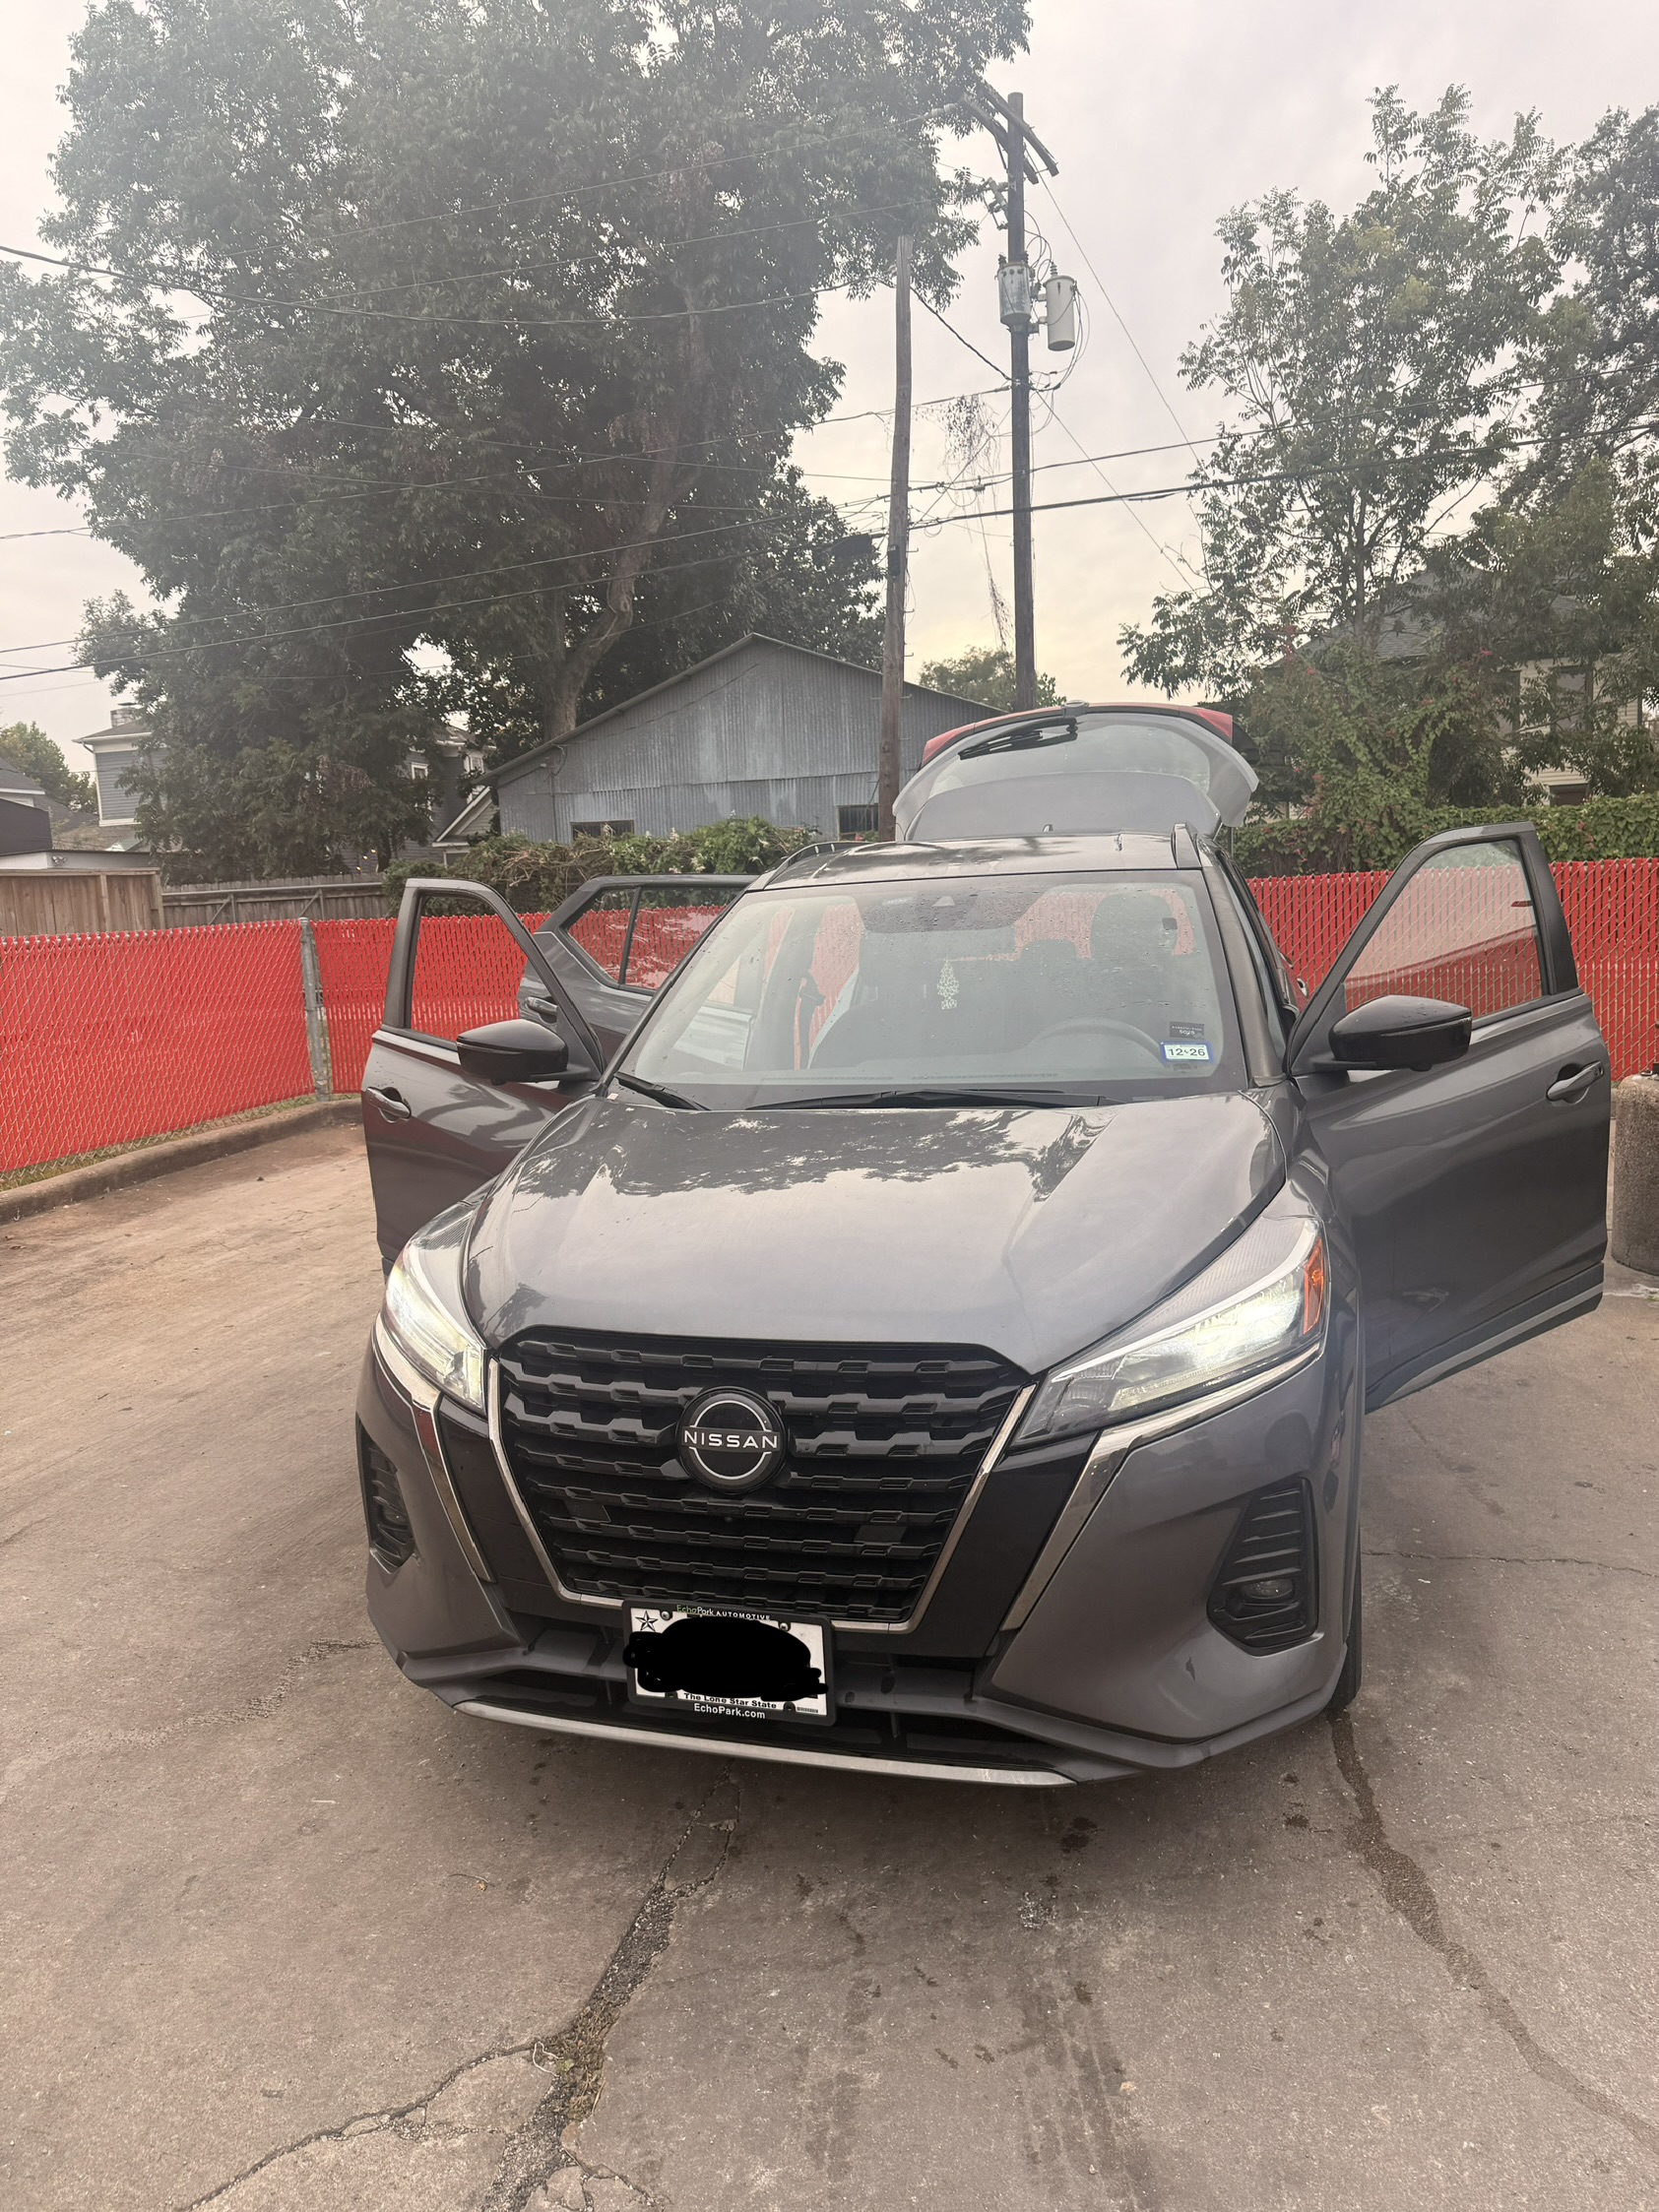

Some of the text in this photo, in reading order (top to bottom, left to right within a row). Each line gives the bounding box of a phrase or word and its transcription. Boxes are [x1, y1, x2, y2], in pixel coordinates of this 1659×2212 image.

[684, 1430, 778, 1449] NISSAN
[676, 1605, 771, 1620] EchoPark AUTOMOTIVE
[683, 1692, 701, 1701] The
[730, 1697, 749, 1706] Star
[751, 1699, 777, 1709] State
[694, 1703, 765, 1719] EchoPark.com
